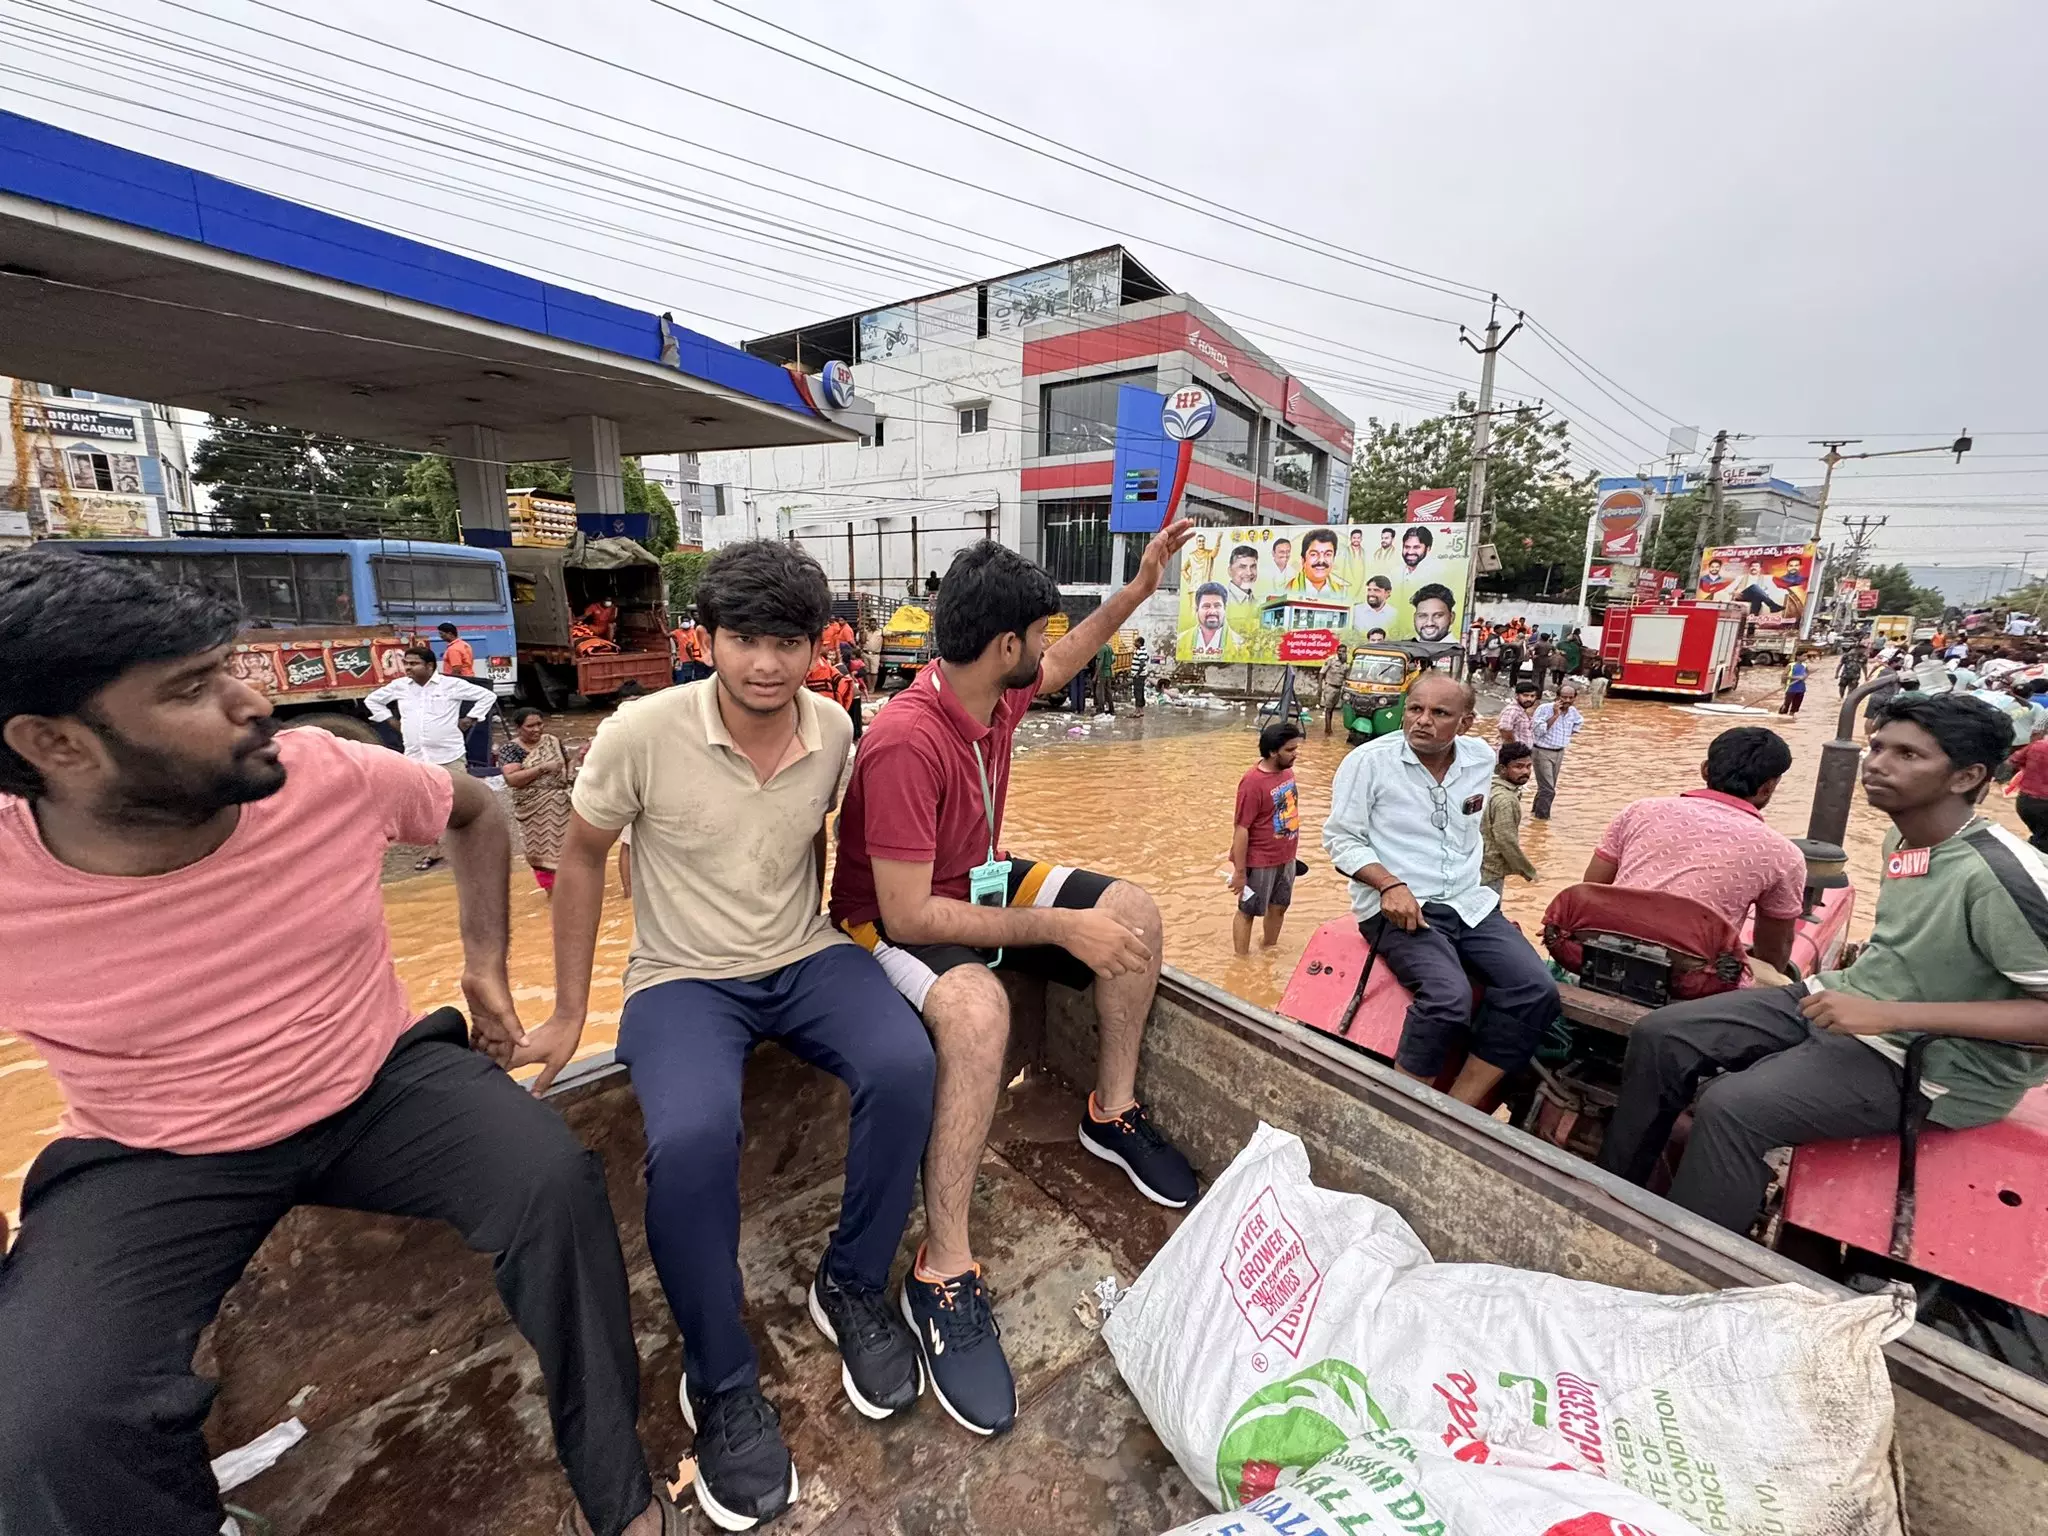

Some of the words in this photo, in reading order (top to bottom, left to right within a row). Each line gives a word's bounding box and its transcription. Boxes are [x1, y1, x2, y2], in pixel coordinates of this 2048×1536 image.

[1198, 339, 1228, 368] HONDA
[837, 367, 850, 384] HP
[1176, 392, 1202, 409] HP
[48, 410, 98, 423] BRIGHT
[72, 423, 133, 436] ACADEMY
[1901, 851, 1928, 875] ABVP
[1234, 1212, 1268, 1261] LAYER
[1238, 1228, 1288, 1290] GROWER
[1261, 1267, 1301, 1317] CRUMBS
[1639, 1435, 1662, 1465] OF
[1651, 1389, 1697, 1504] CONDITION
[1698, 1461, 1730, 1532] PRICE
